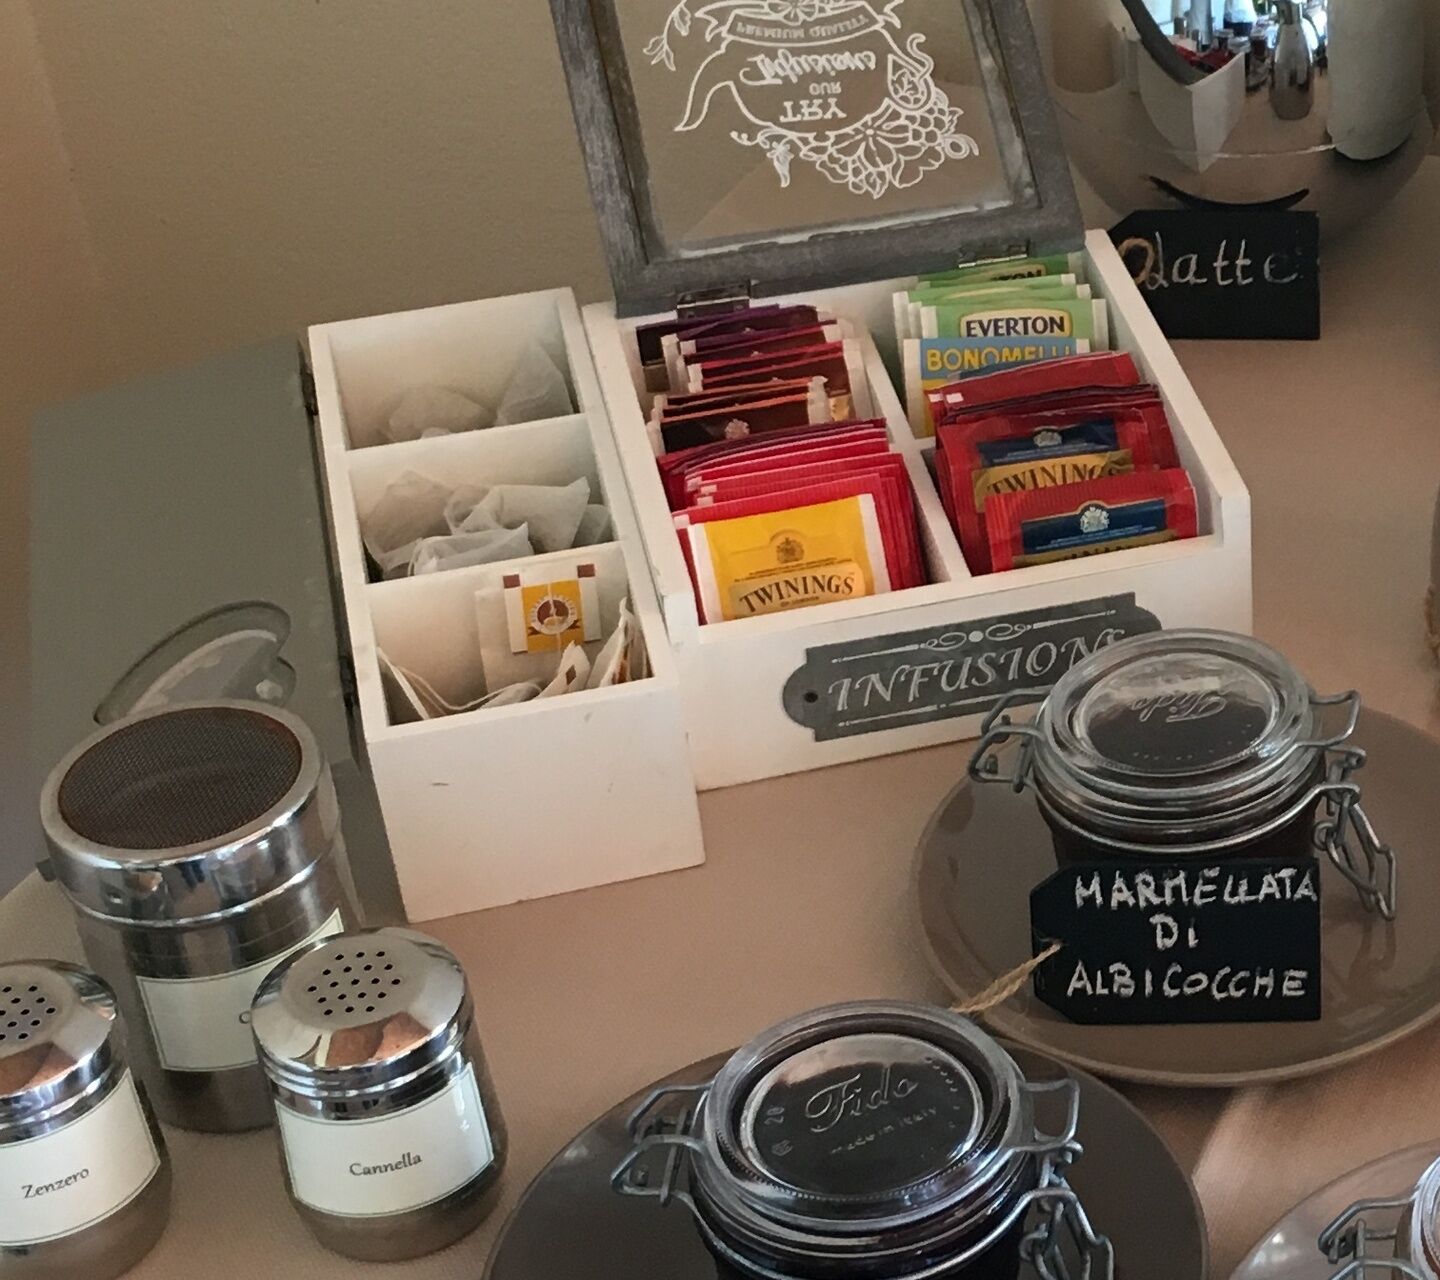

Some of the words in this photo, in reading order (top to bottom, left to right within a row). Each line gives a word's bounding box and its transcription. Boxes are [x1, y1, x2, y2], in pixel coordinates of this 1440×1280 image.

[965, 316, 1065, 338] EVERTON
[740, 574, 855, 613] TWININGS
[1074, 867, 1319, 910] MARMELLATA
[1149, 914, 1199, 950] DI
[1067, 960, 1308, 1000] ALBICOCCHE
[805, 1064, 918, 1133] Fido
[349, 1151, 423, 1176] Cannella
[21, 1168, 90, 1199] Zenzero
